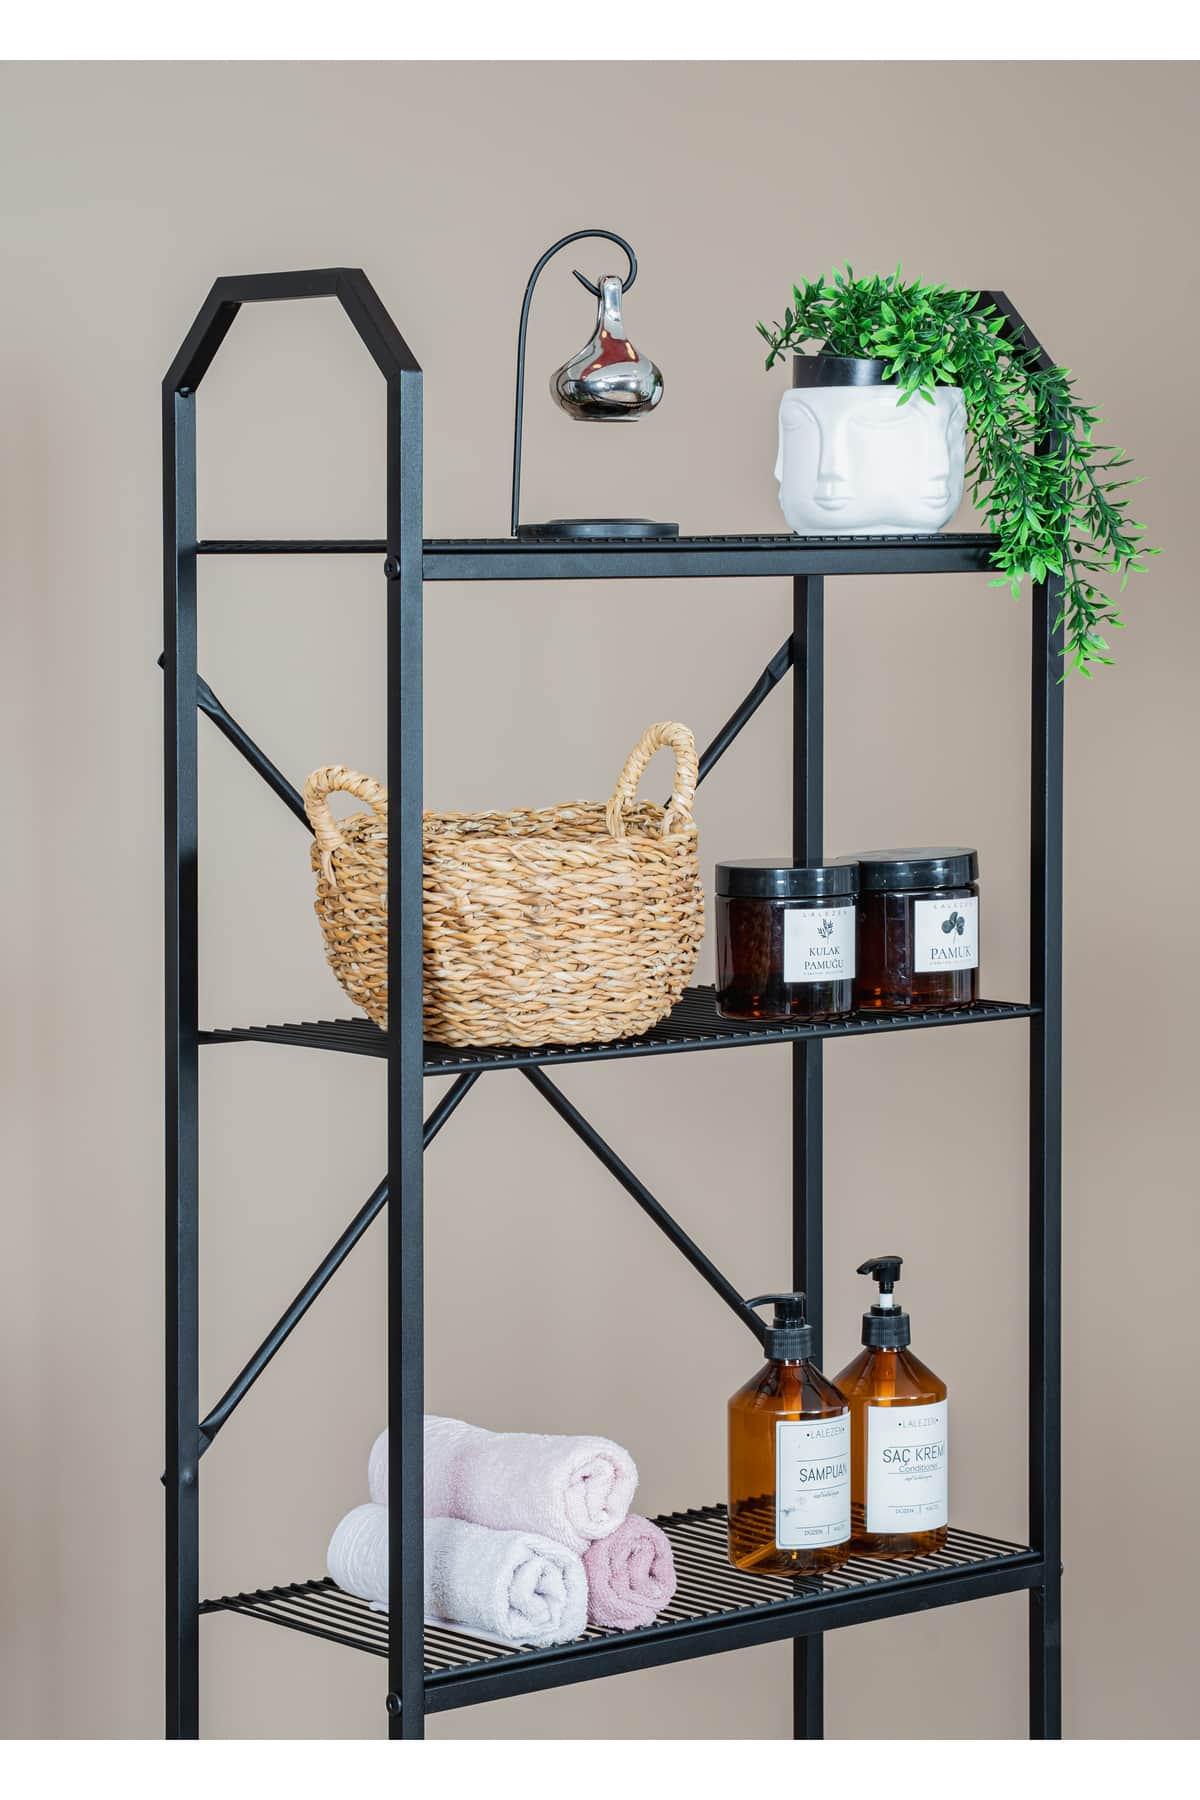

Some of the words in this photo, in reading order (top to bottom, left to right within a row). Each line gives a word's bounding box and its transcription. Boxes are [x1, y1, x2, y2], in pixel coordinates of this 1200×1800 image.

[809, 946, 840, 957] KULAK
[931, 946, 971, 960] PAMUK
[804, 958, 844, 970] PAMUĞU
[882, 1448, 911, 1466] SAÇ
